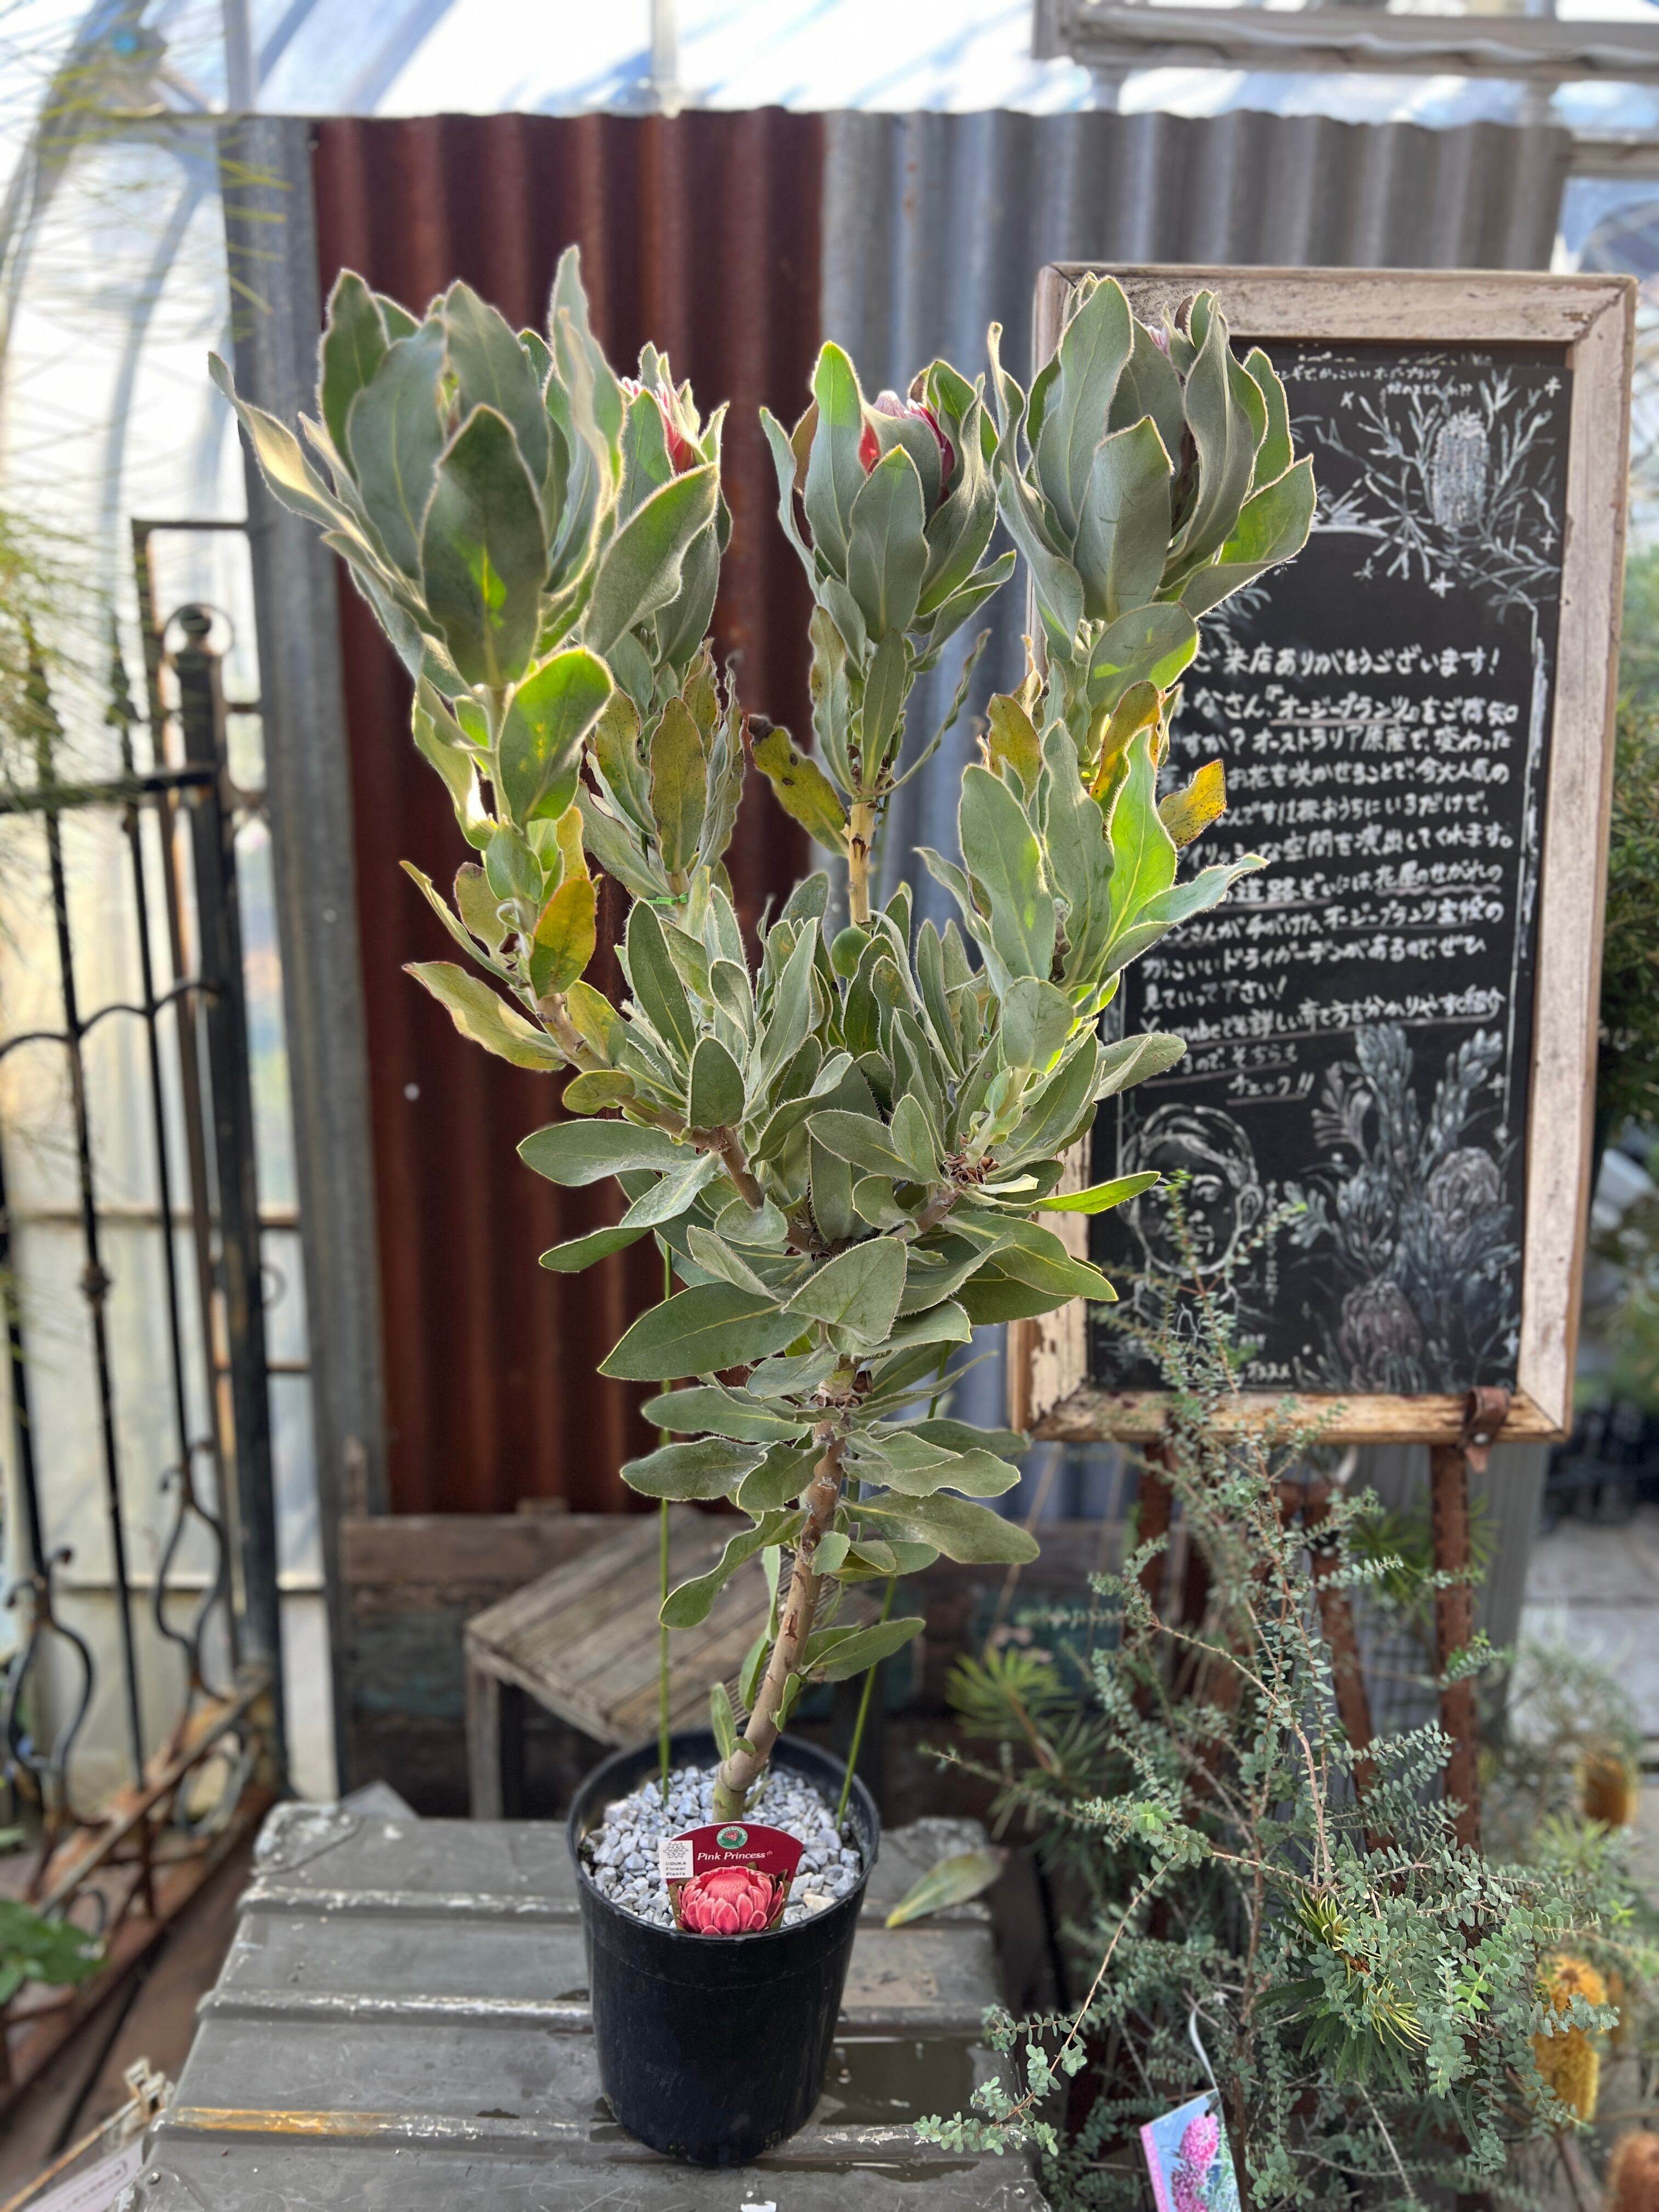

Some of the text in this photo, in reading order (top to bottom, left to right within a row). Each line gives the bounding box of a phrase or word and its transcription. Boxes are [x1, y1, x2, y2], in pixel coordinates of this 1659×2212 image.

[1170, 724, 1511, 759] すか?オーストラリア原産で、変わった
[697, 1852, 721, 1860] Pink
